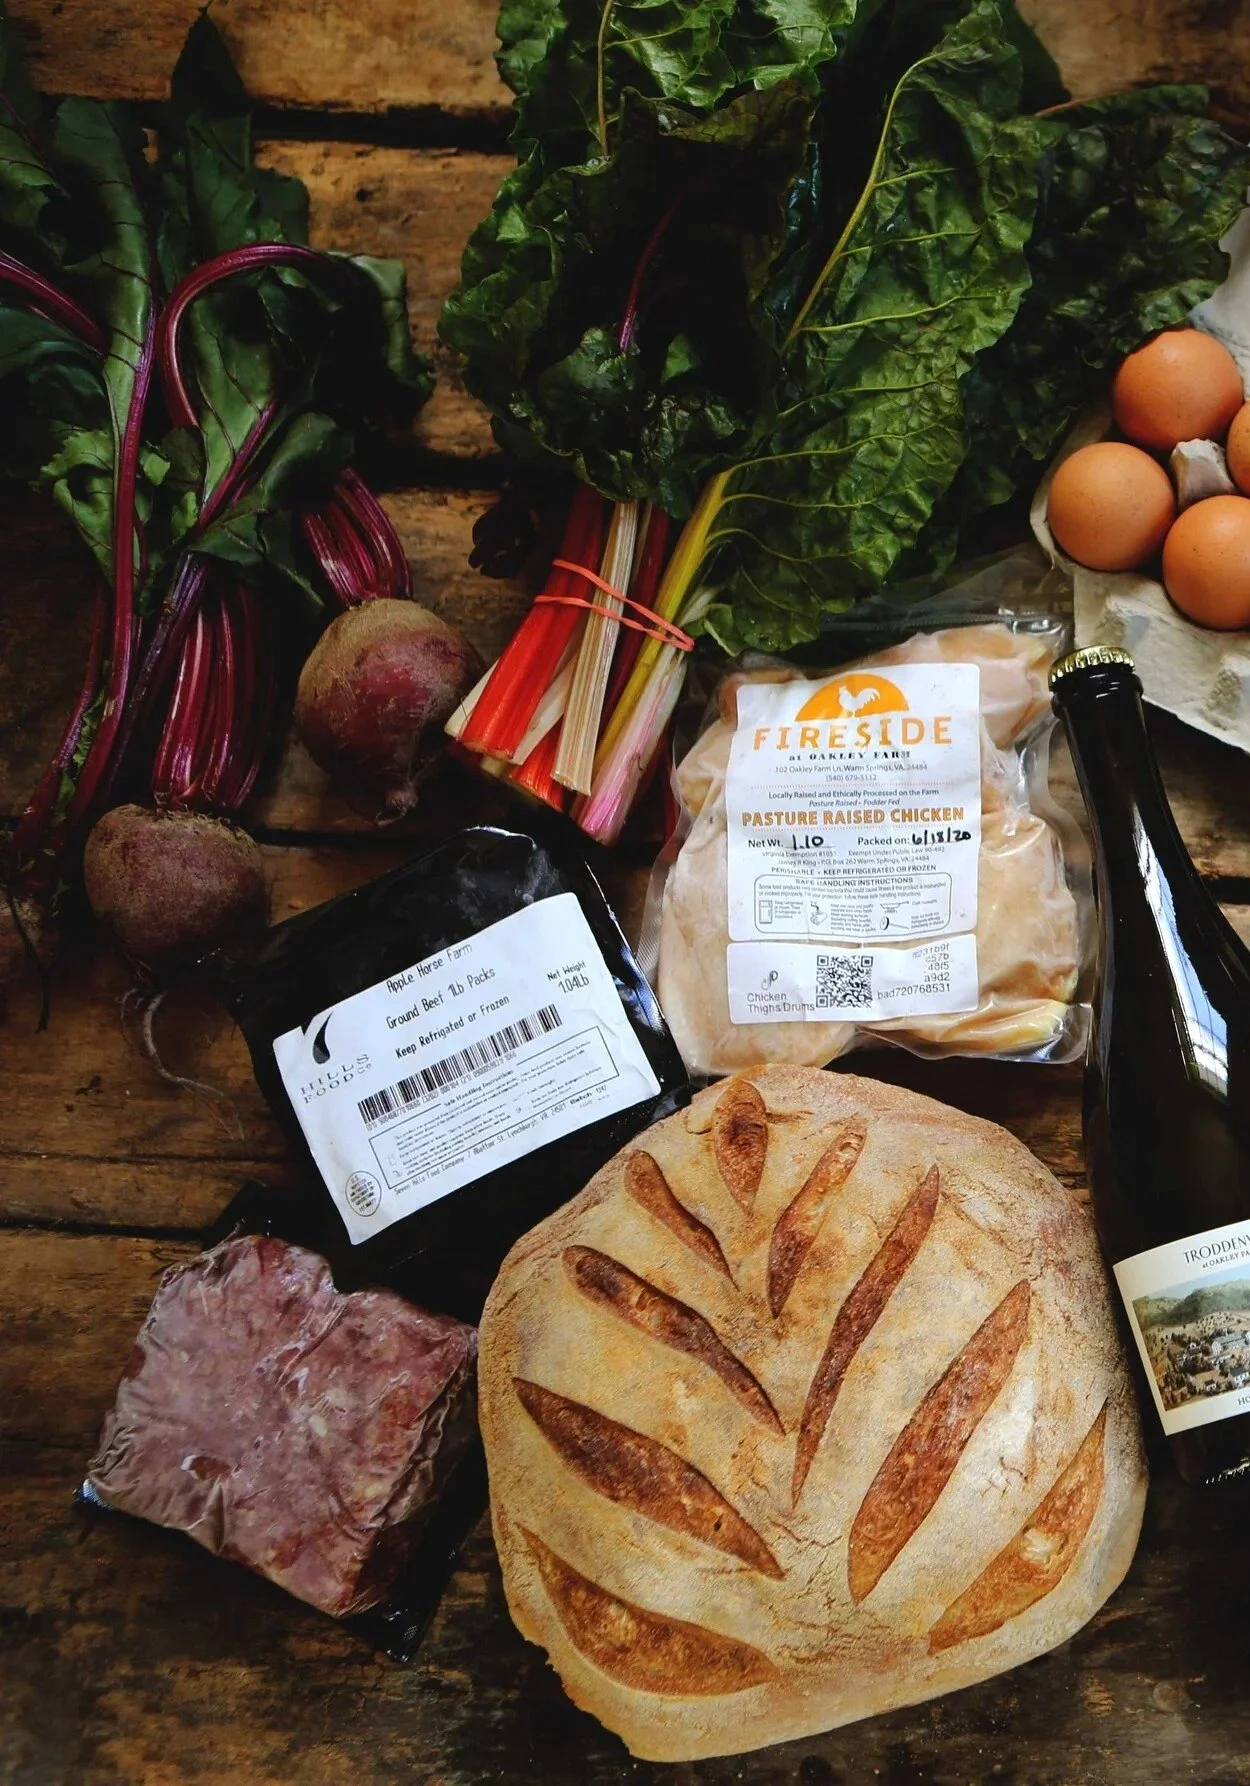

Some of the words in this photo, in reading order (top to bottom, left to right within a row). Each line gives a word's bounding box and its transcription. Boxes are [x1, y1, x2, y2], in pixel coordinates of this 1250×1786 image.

[753, 716, 953, 751] FIRESIDE
[809, 751, 866, 761] OAKLEY
[874, 751, 911, 760] FARM
[789, 765, 813, 774] Oakley
[813, 764, 831, 772] Farm
[843, 764, 864, 772] Warm
[826, 774, 843, 782] (540)
[768, 791, 793, 800] Locally
[817, 790, 832, 798] and
[832, 789, 862, 799] Ethically
[863, 789, 897, 797] Processed
[809, 800, 834, 808] Pasture
[863, 798, 887, 806] Fodder
[741, 811, 818, 827] PASTURE
[823, 808, 884, 825] RAISED
[891, 807, 964, 823] CHICKEN
[749, 840, 767, 848] Net
[768, 839, 784, 848] Wt.
[792, 834, 824, 850] 1.10
[857, 837, 893, 845] Packed
[894, 837, 910, 845] on:
[912, 827, 971, 845] 6/18/20
[842, 867, 894, 875] REFRIGERATED
[907, 864, 936, 873] FROZEN
[857, 877, 913, 886] INSTRUCTIONS
[386, 973, 414, 993] Apple
[416, 957, 444, 978] Horse
[446, 942, 473, 962] Farm
[546, 969, 561, 982] Net
[562, 960, 587, 975] Weight
[386, 1004, 419, 1030] Ground
[421, 990, 444, 1012] Beef
[466, 966, 496, 989] Packs
[747, 992, 787, 1002] Chicken
[395, 1043, 417, 1059] Keep
[418, 1016, 465, 1046] Refrigated
[467, 1012, 477, 1022] or
[480, 995, 510, 1017] Frozen
[300, 1054, 369, 1094] HILLS
[304, 1072, 354, 1104] FOOD
[1209, 1252, 1240, 1267] OAKLEY
